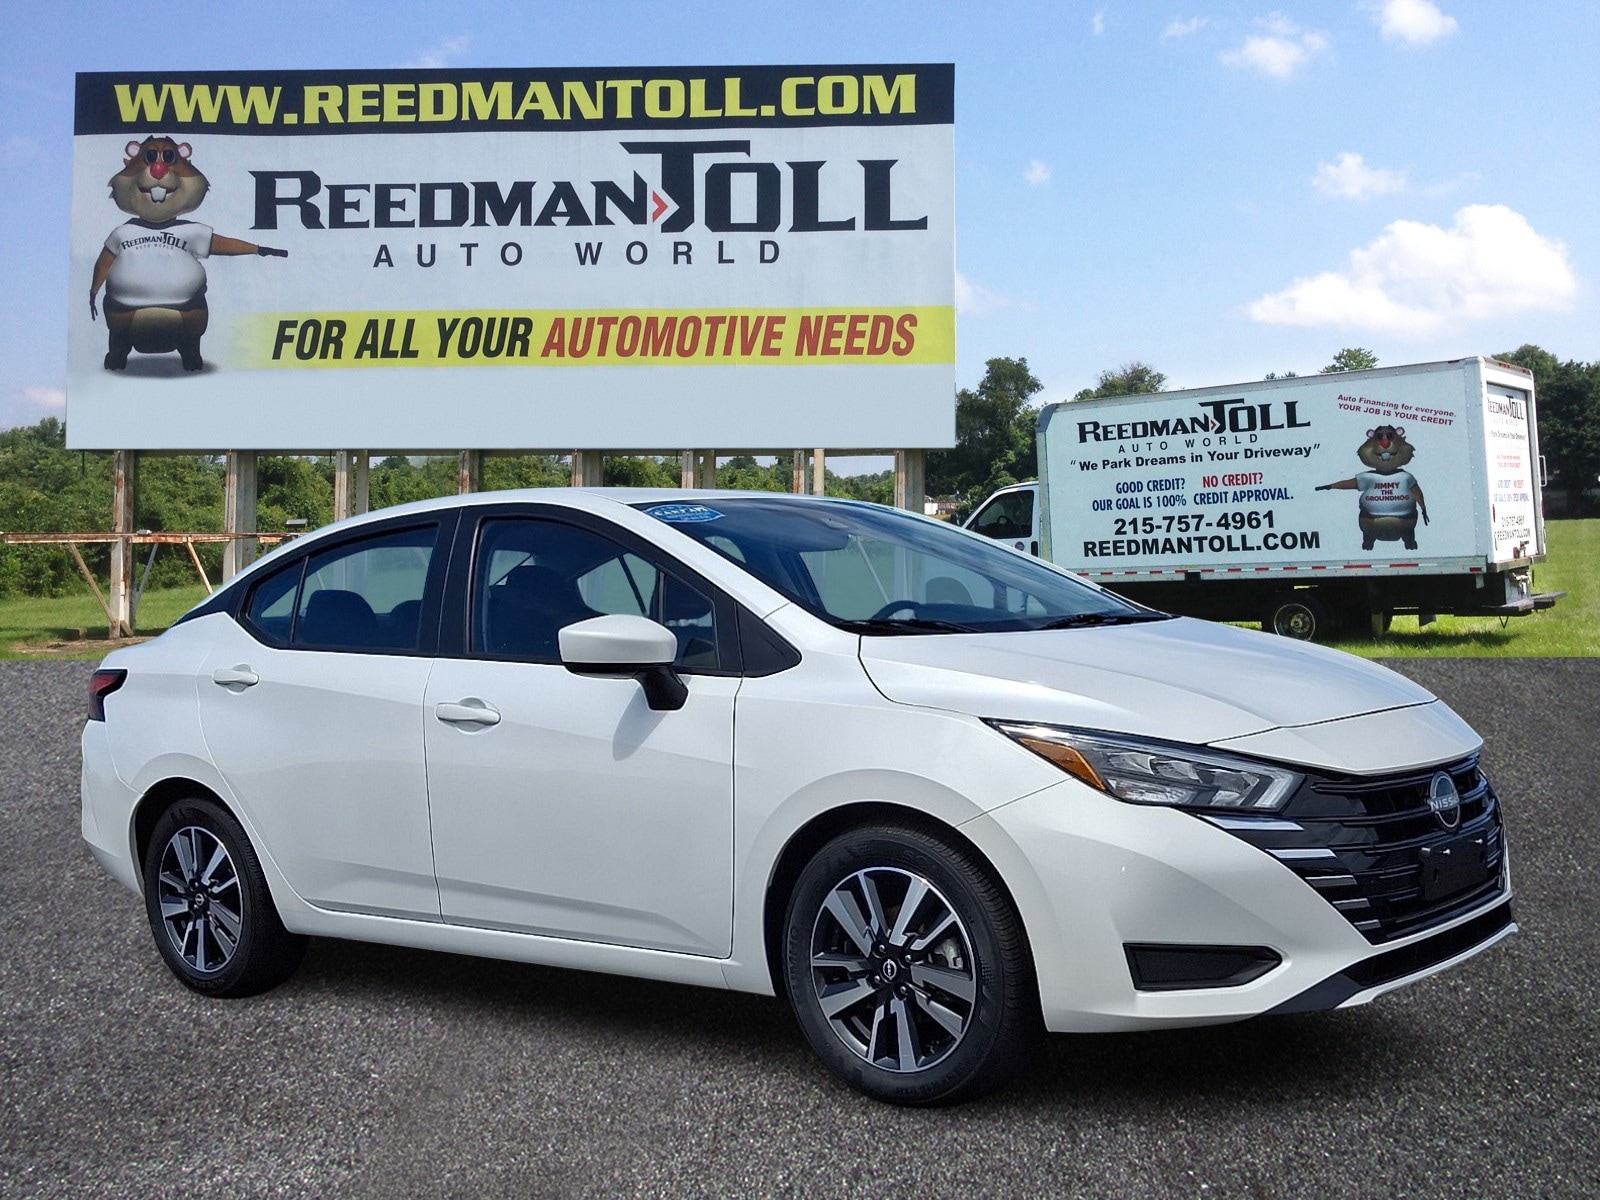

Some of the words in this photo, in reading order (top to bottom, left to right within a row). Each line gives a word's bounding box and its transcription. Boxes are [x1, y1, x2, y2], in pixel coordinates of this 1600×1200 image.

[113, 73, 917, 125] WWW.REEDMANTOLL.COM
[373, 241, 524, 267] AUTO
[575, 239, 781, 266] WORLD
[272, 318, 346, 360] FOR
[354, 318, 419, 359] ALL
[436, 316, 533, 359] YOUR
[541, 314, 787, 358] AUTOMOTIVE
[794, 312, 918, 357] NEEDS
[1337, 394, 1357, 403] Auto
[1358, 396, 1399, 410] Financing
[1401, 403, 1413, 411] for
[1415, 406, 1457, 418] everyone.
[1338, 402, 1362, 412] YOUR
[1363, 406, 1381, 416] JOB
[1382, 409, 1392, 417] IS
[1394, 411, 1418, 421] YOUR
[1420, 414, 1454, 426] CREDIT
[1118, 441, 1169, 454] AUTO
[1184, 433, 1258, 449] WORLD
[1102, 457, 1131, 470] Park
[1135, 454, 1186, 467] Dreams
[1190, 452, 1203, 463] in
[1207, 450, 1240, 461] Your
[1115, 481, 1144, 494] GOOD
[1146, 478, 1186, 492] CREDIT?
[1202, 475, 1219, 488] NO
[1221, 471, 1264, 486] CREDIT?
[1373, 481, 1401, 490] JIMMY
[1092, 499, 1113, 512] OUR
[1115, 497, 1141, 510] GOAL
[1143, 496, 1153, 508] IS
[1156, 493, 1187, 508] 100%
[1193, 491, 1229, 506] CREDIT
[1231, 487, 1294, 503] APPROVAL.
[1365, 494, 1410, 502] GROUNDHOG
[1114, 509, 1275, 536] 215-757-4961
[1083, 531, 1320, 558] REEDMANTOLL.COM
